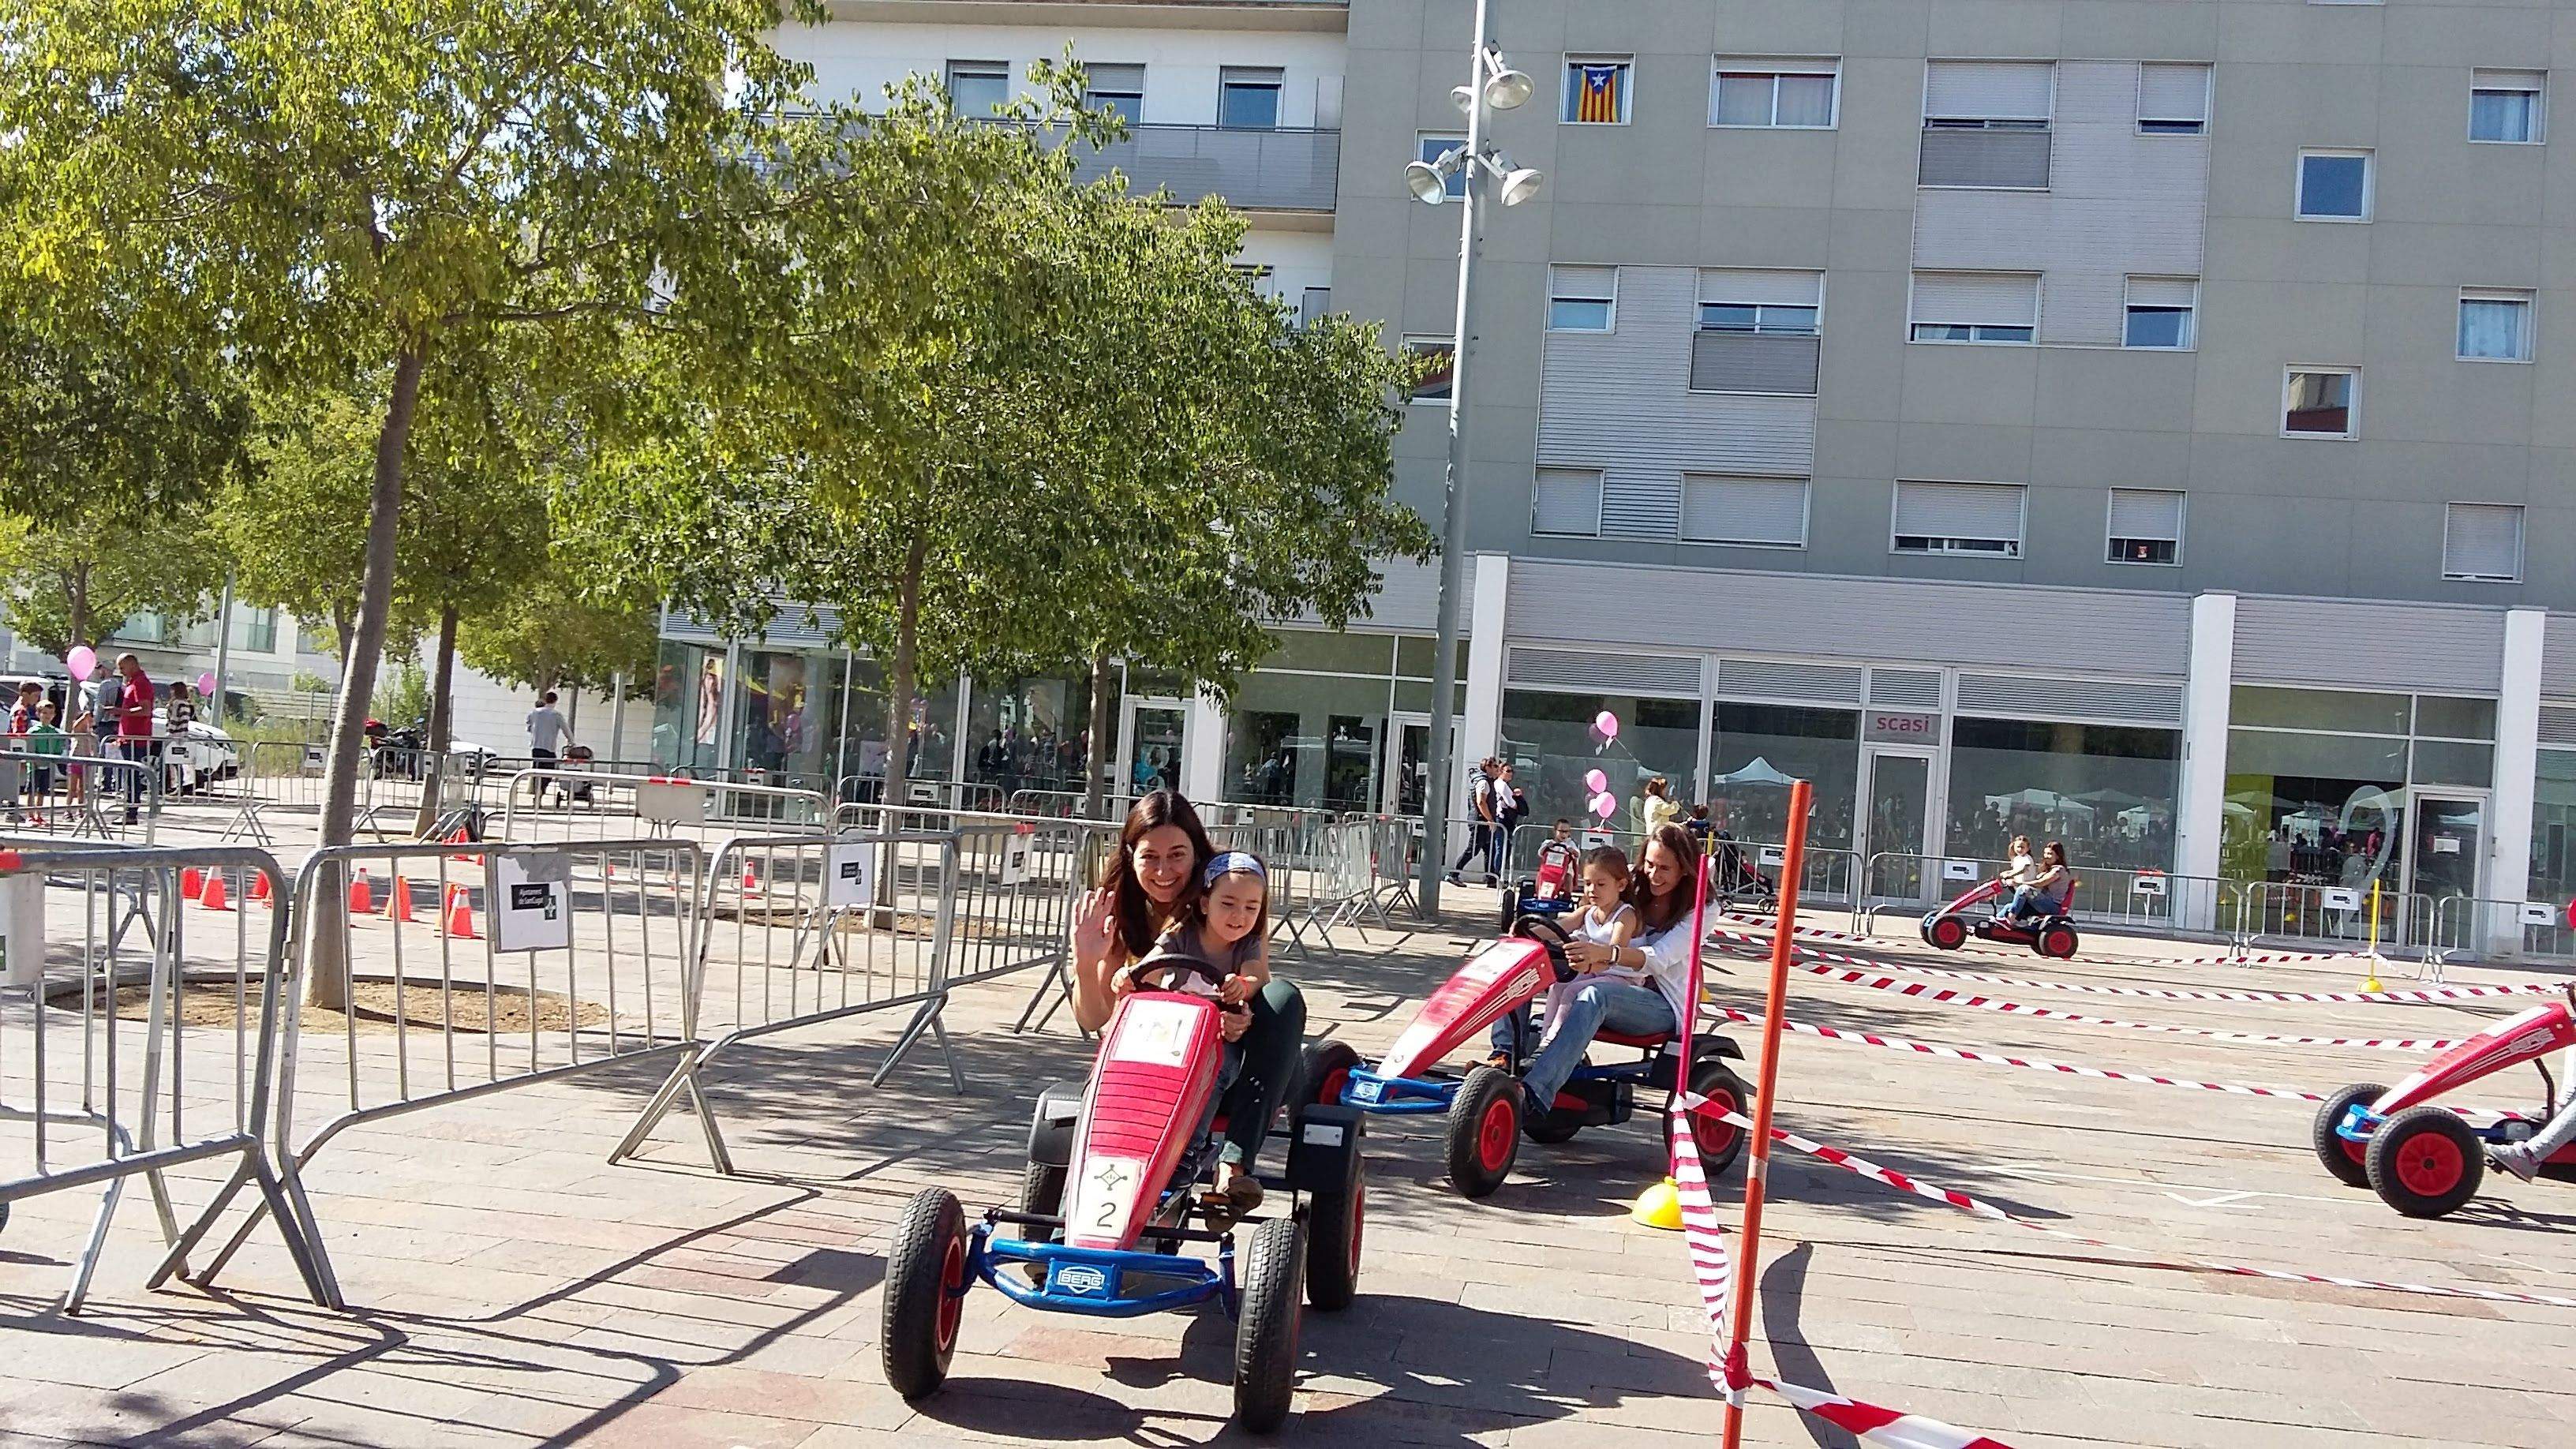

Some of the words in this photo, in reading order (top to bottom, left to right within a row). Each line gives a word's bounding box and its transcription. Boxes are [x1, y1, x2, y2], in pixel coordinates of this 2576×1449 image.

[1876, 716, 1929, 732] scasi
[1096, 1202, 1117, 1228] 2
[1059, 1271, 1103, 1288] BERG
